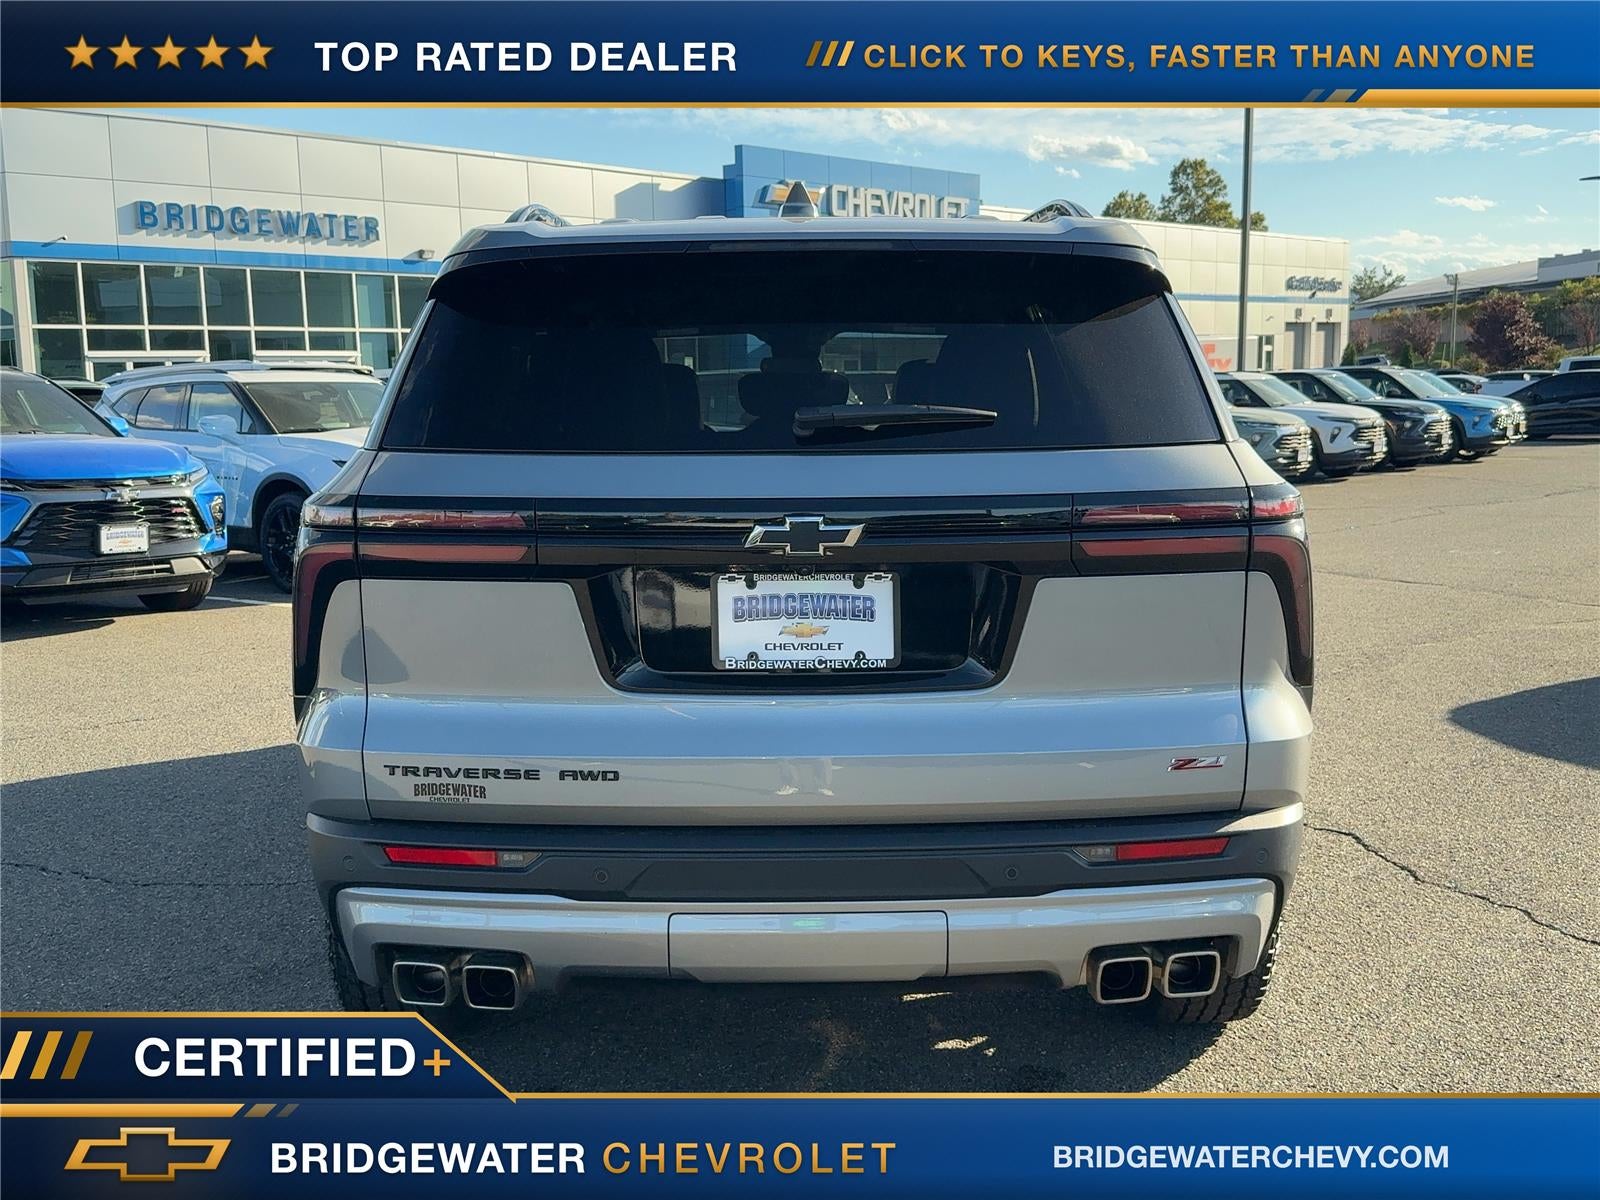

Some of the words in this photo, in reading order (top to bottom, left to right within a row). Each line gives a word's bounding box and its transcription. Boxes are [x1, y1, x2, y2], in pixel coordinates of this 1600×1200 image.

[829, 184, 970, 218] CHEVROLET
[136, 200, 380, 241] BRIDGEWATER
[732, 592, 877, 622] BRIDGEWATER
[764, 642, 844, 651] CHEVROLET
[383, 764, 541, 781] TRAVERSE
[558, 769, 620, 782] AWD
[413, 782, 487, 799] BRIDGEWATER
